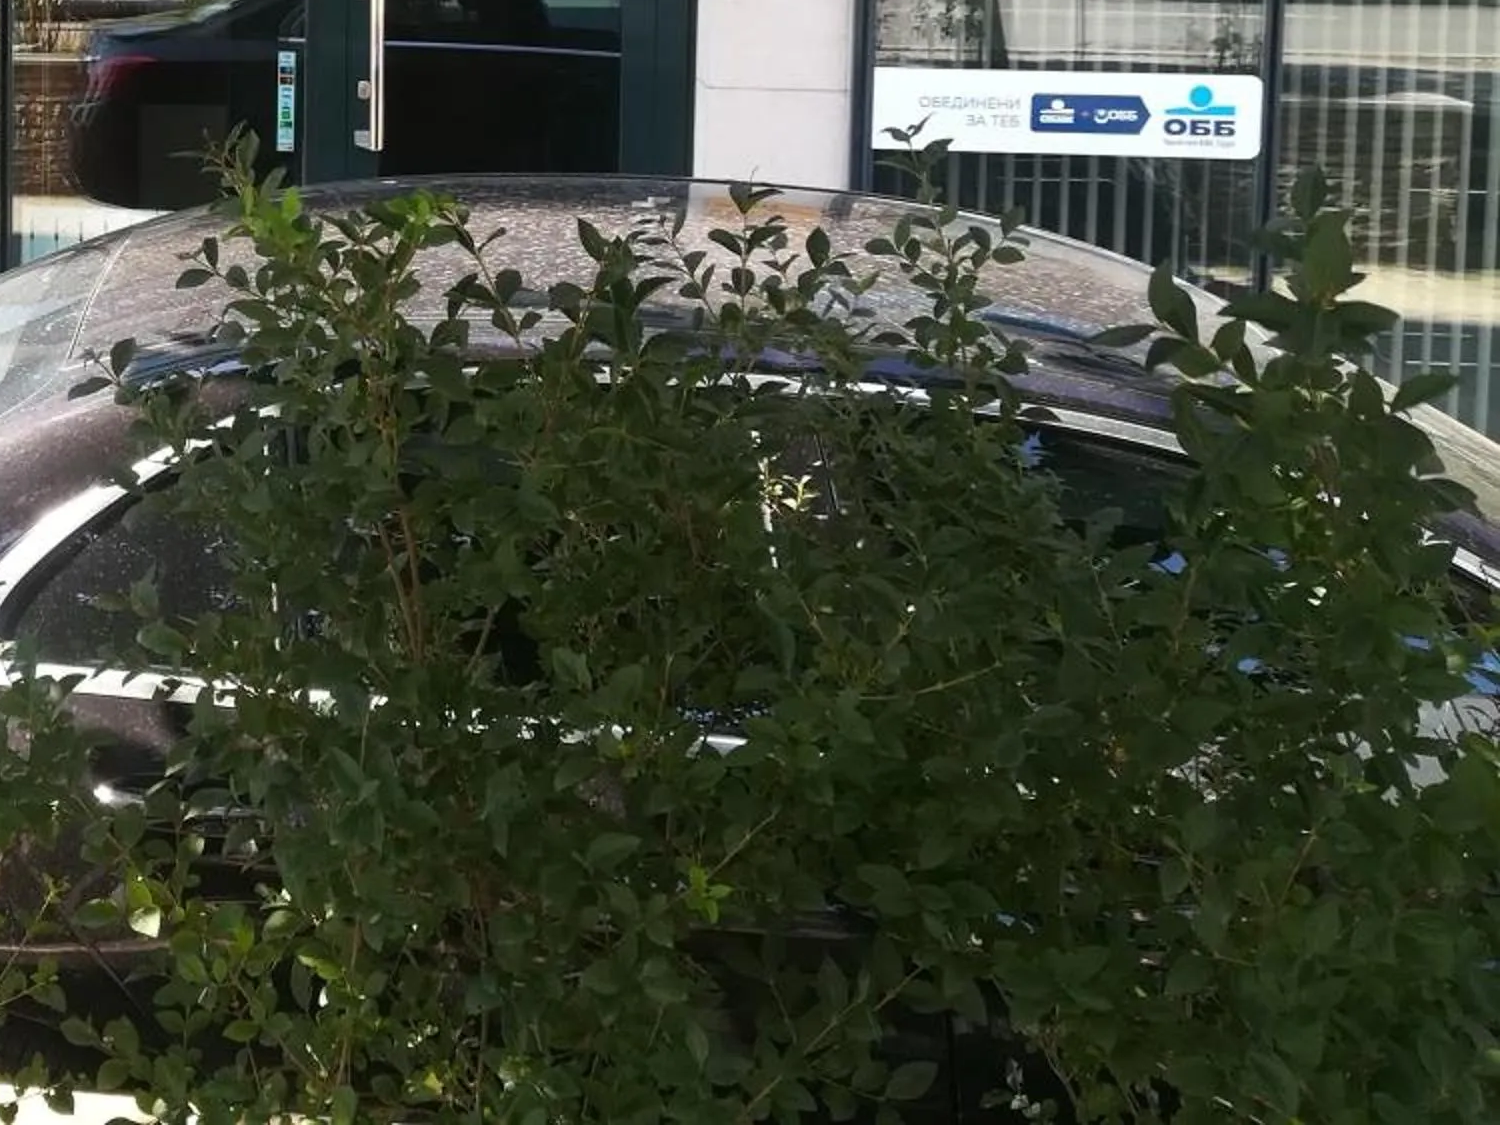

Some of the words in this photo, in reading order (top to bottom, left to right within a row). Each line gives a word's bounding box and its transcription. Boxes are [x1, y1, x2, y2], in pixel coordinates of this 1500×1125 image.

[918, 95, 1022, 110] ОБЕДИНЕНИ
[964, 113, 987, 127] ЗА
[990, 114, 1022, 128] ТЕБ
[1163, 118, 1236, 137] ОББ
